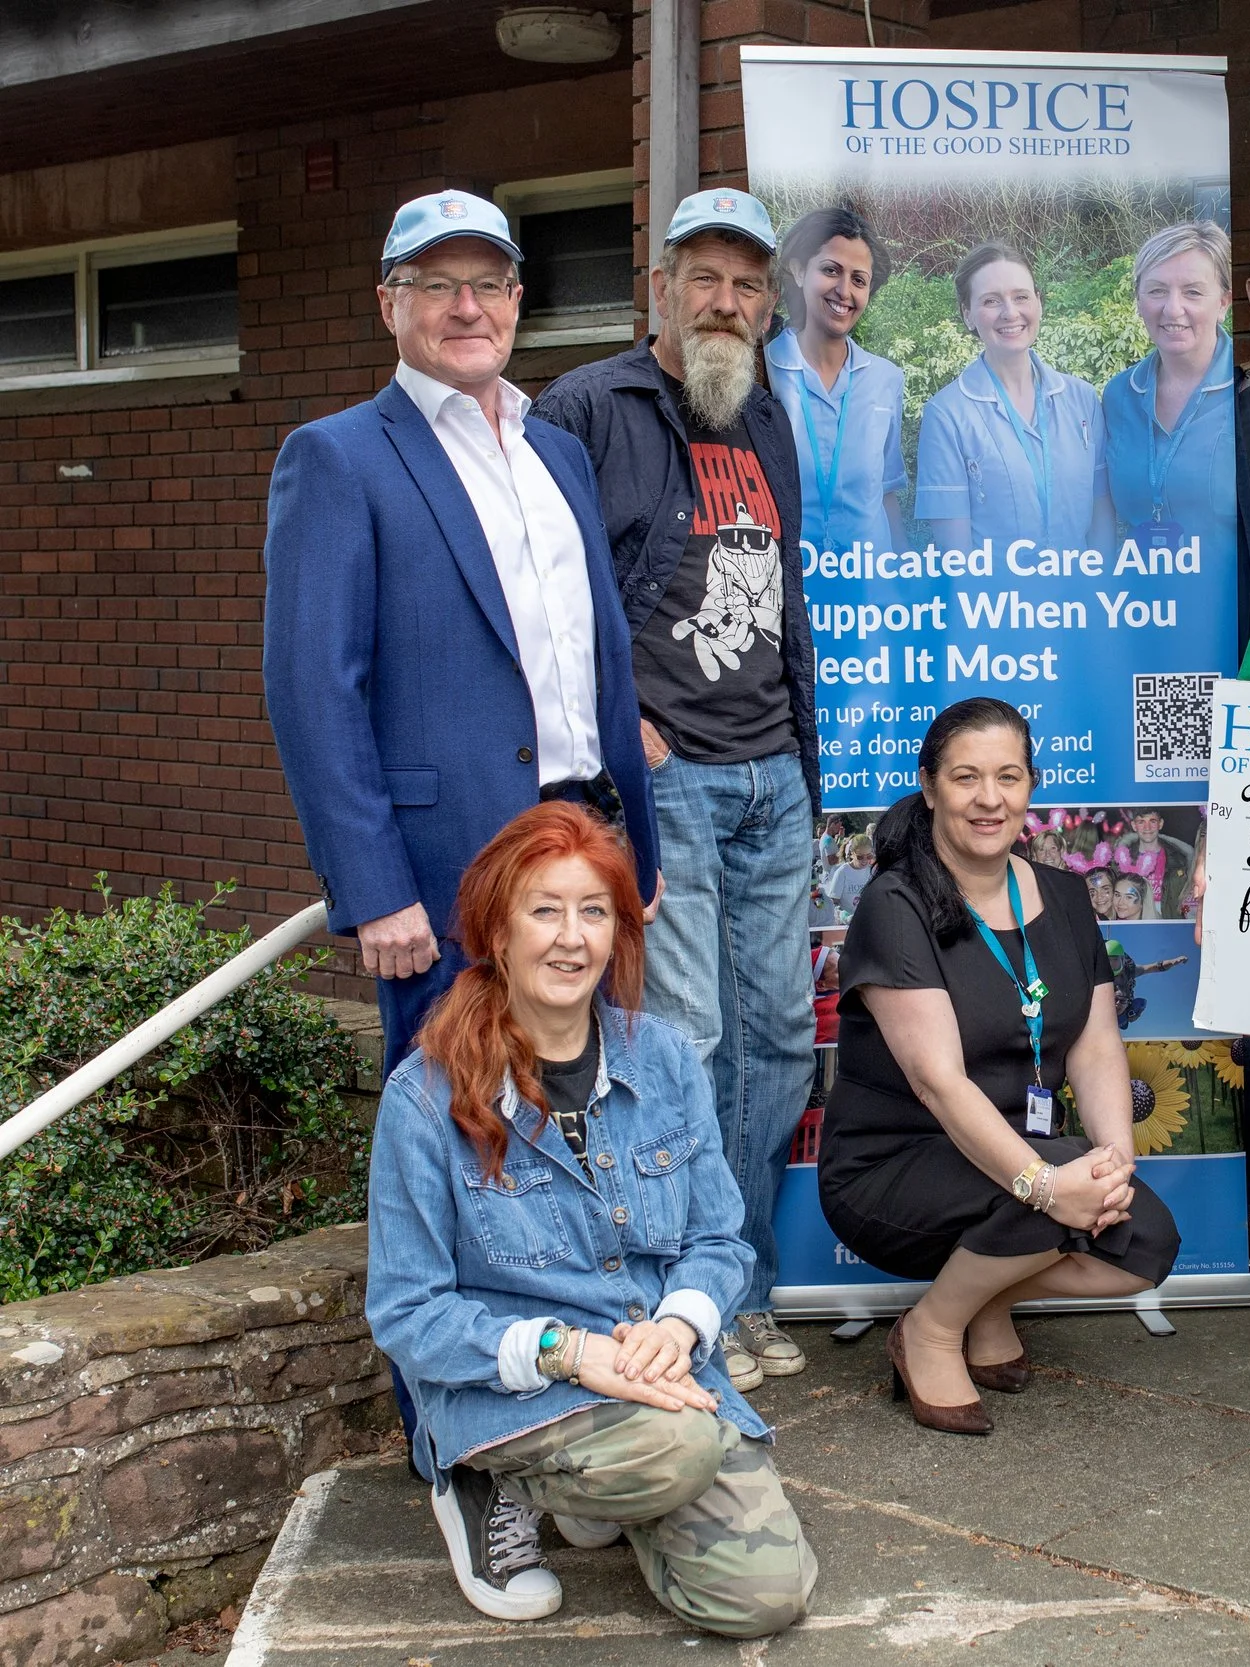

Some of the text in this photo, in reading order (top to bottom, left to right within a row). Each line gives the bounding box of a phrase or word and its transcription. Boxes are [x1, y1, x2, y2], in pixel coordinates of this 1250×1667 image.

[839, 79, 1133, 132] HOSPICE
[846, 135, 1130, 156] OF THE GOOD SHEPHERD
[799, 536, 1200, 579] Dedicated Care And
[957, 591, 1087, 629] When
[1096, 591, 1176, 629] You
[814, 645, 1058, 684] eed It Most
[836, 708, 864, 727] up
[871, 702, 904, 722] for
[910, 705, 936, 721] an
[849, 740, 861, 755] a
[1051, 730, 1092, 751] and
[1145, 764, 1208, 778] Scan me
[1221, 756, 1249, 774] OF
[1210, 802, 1233, 819] Pay
